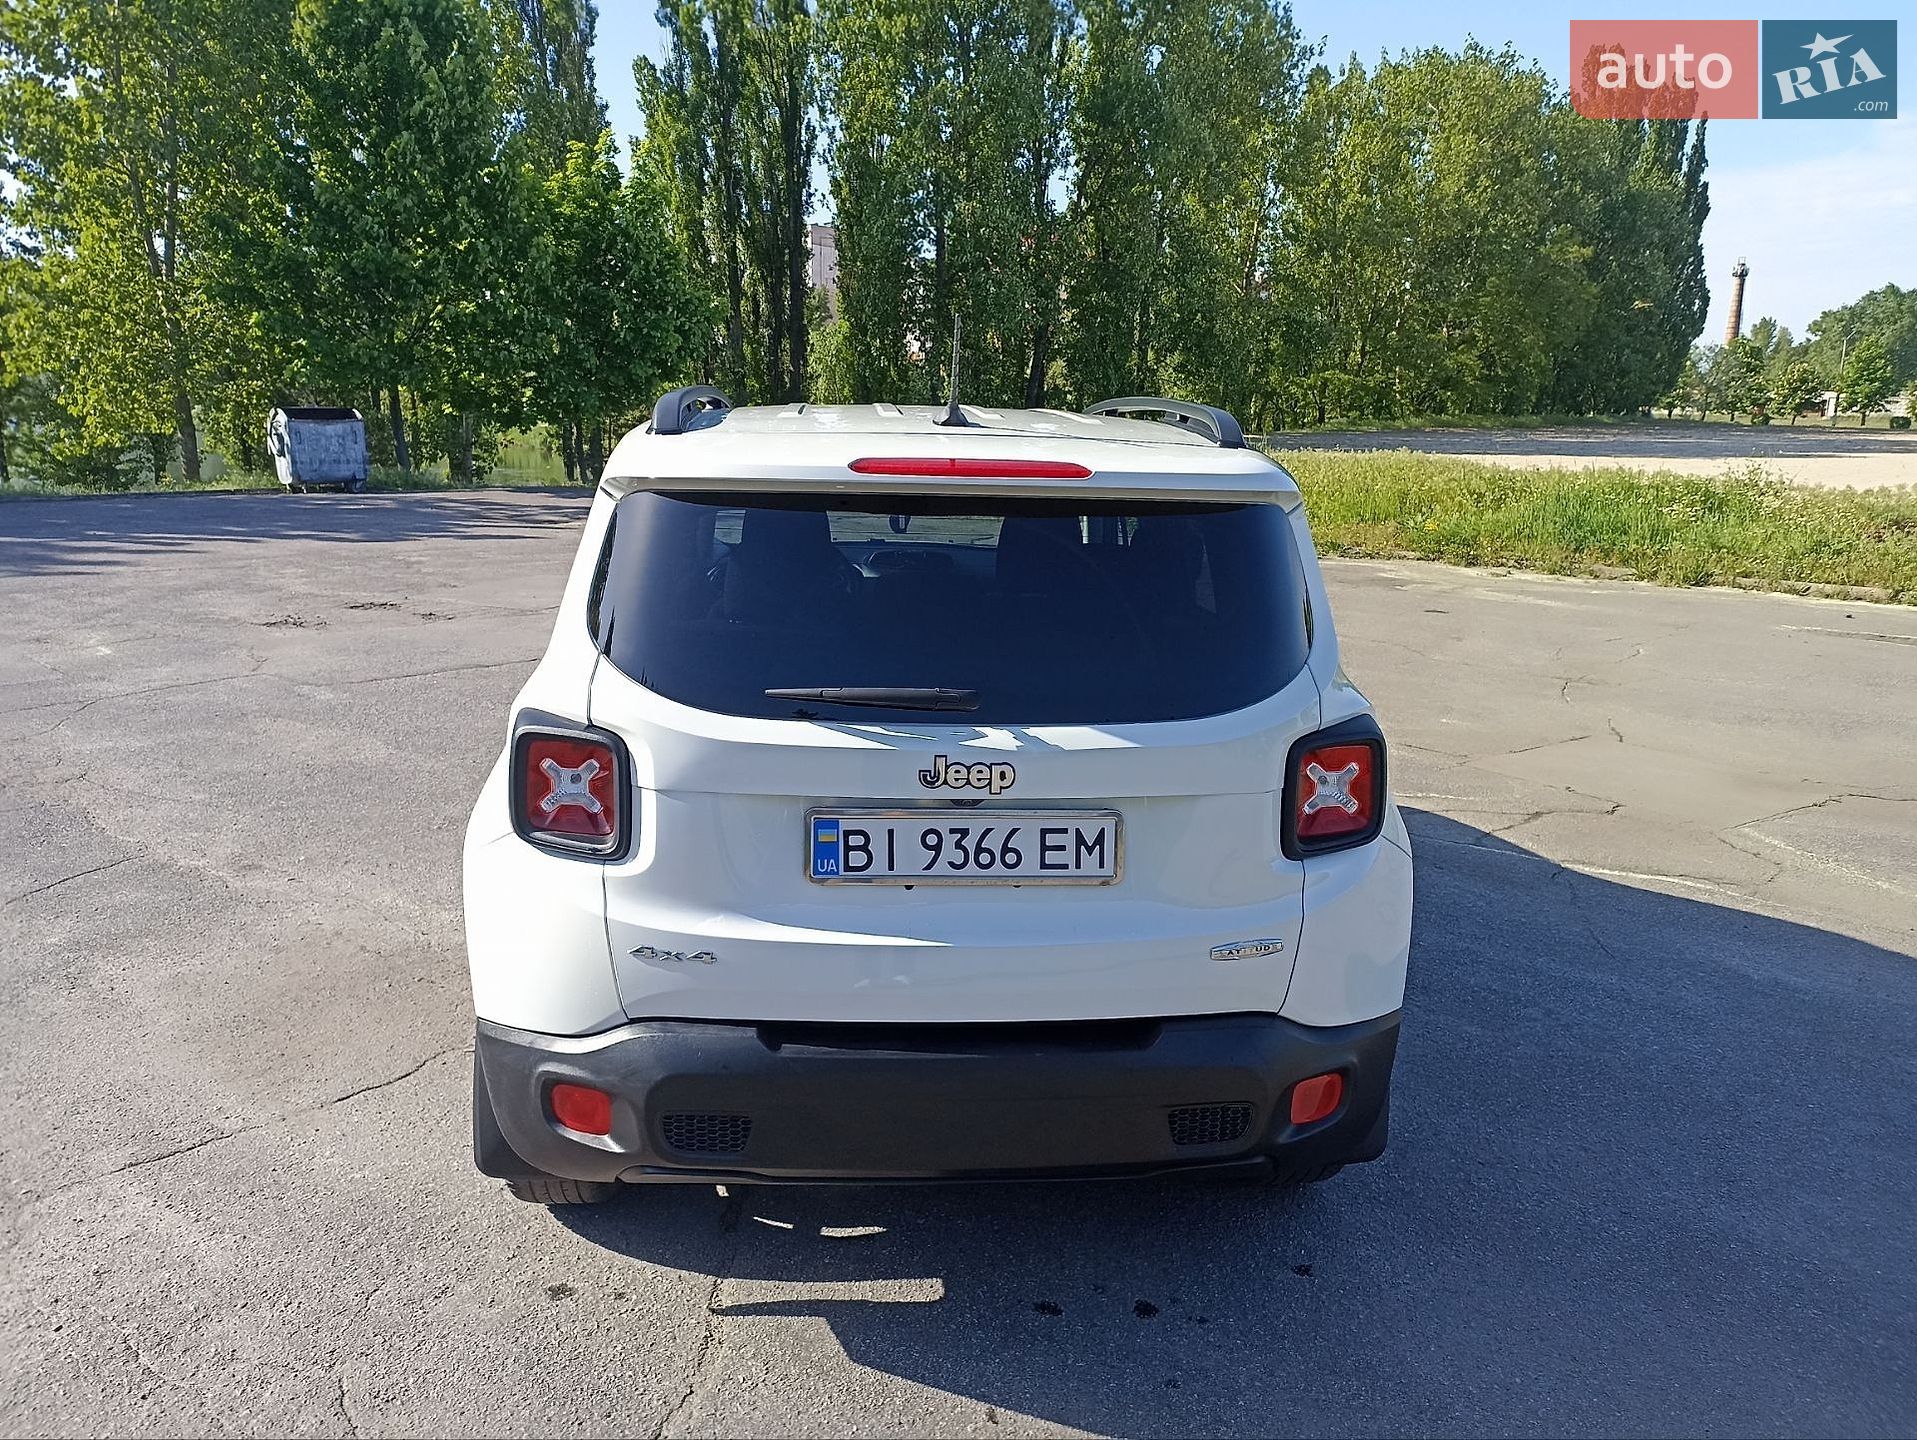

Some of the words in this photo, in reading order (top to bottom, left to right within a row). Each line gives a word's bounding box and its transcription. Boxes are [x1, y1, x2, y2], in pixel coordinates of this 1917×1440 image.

[919, 755, 1015, 794] Jeep
[818, 859, 837, 872] UA
[843, 828, 895, 872] BI
[920, 827, 1023, 871] 9366
[1039, 827, 1105, 870] EM
